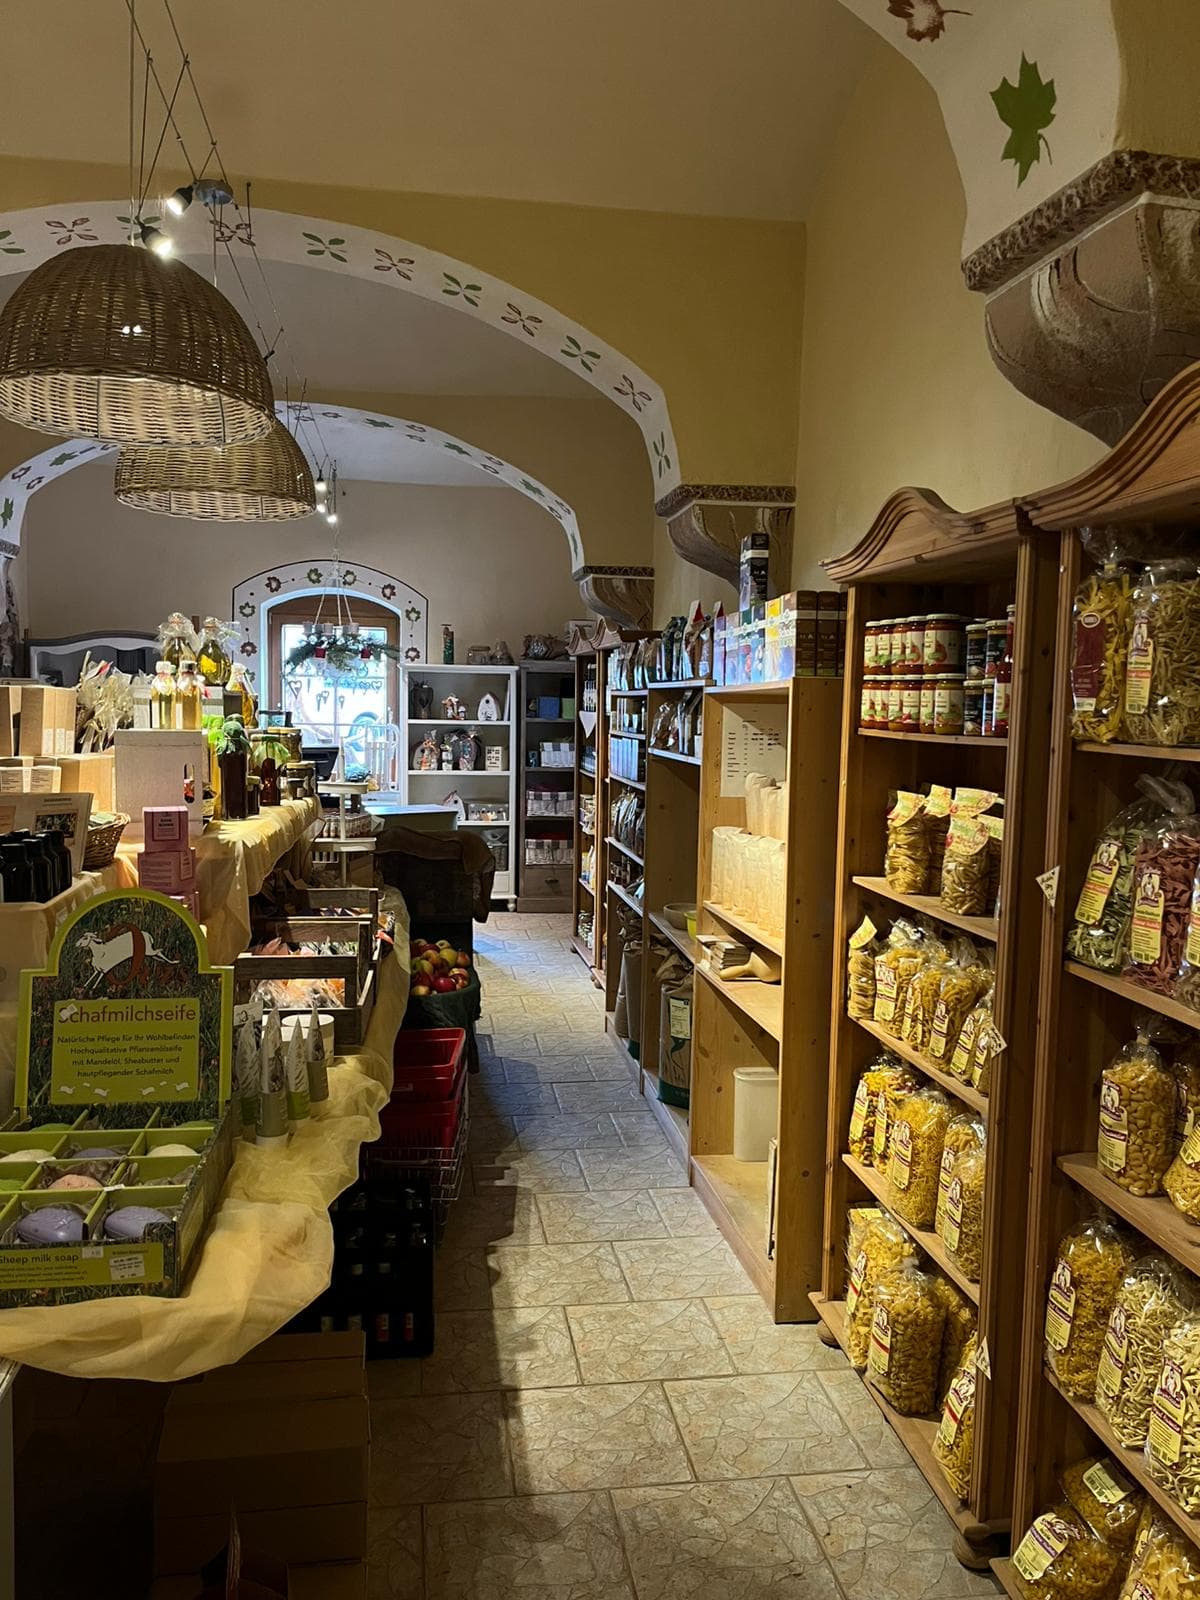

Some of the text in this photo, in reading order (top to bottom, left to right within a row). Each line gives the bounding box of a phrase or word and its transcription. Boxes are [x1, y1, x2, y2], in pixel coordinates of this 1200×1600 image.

[58, 1004, 197, 1024] Schafmilchseife
[57, 1033, 196, 1044] Natürliche Pflege für Ihr Wohlbefinden
[72, 1059, 84, 1067] mit
[124, 1056, 164, 1064] Sheabutter
[165, 1055, 180, 1063] und
[77, 1067, 174, 1079] hautpflegender Schafmilch
[31, 1253, 51, 1263] milk
[55, 1253, 79, 1264] soap
